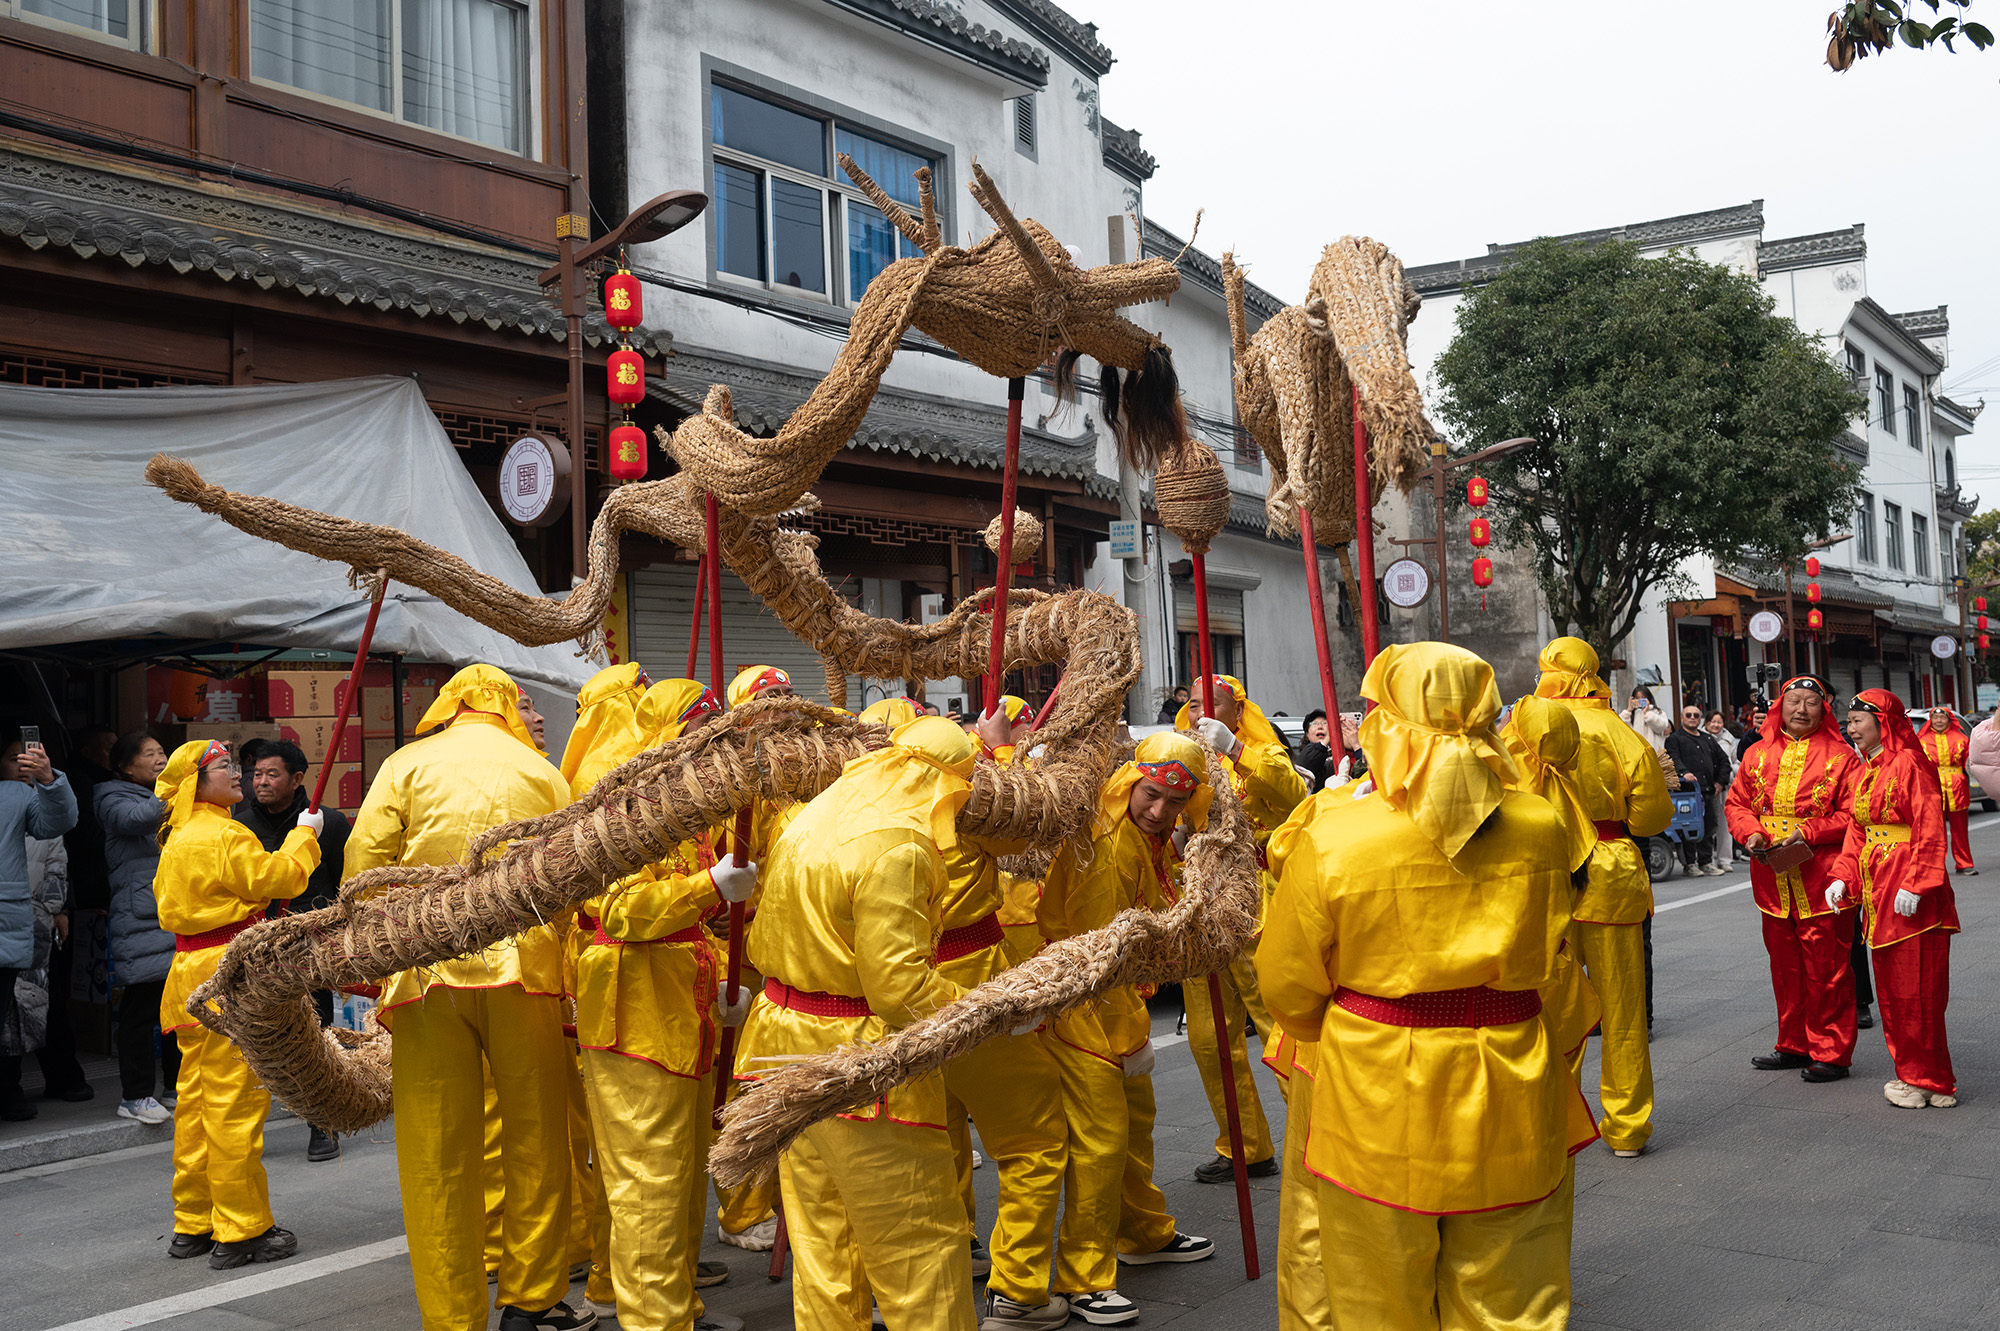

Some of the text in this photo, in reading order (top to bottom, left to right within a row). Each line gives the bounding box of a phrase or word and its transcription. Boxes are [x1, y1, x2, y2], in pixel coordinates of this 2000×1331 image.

[609, 287, 632, 311] 福
[615, 362, 639, 386] 福
[617, 440, 640, 464] 福
